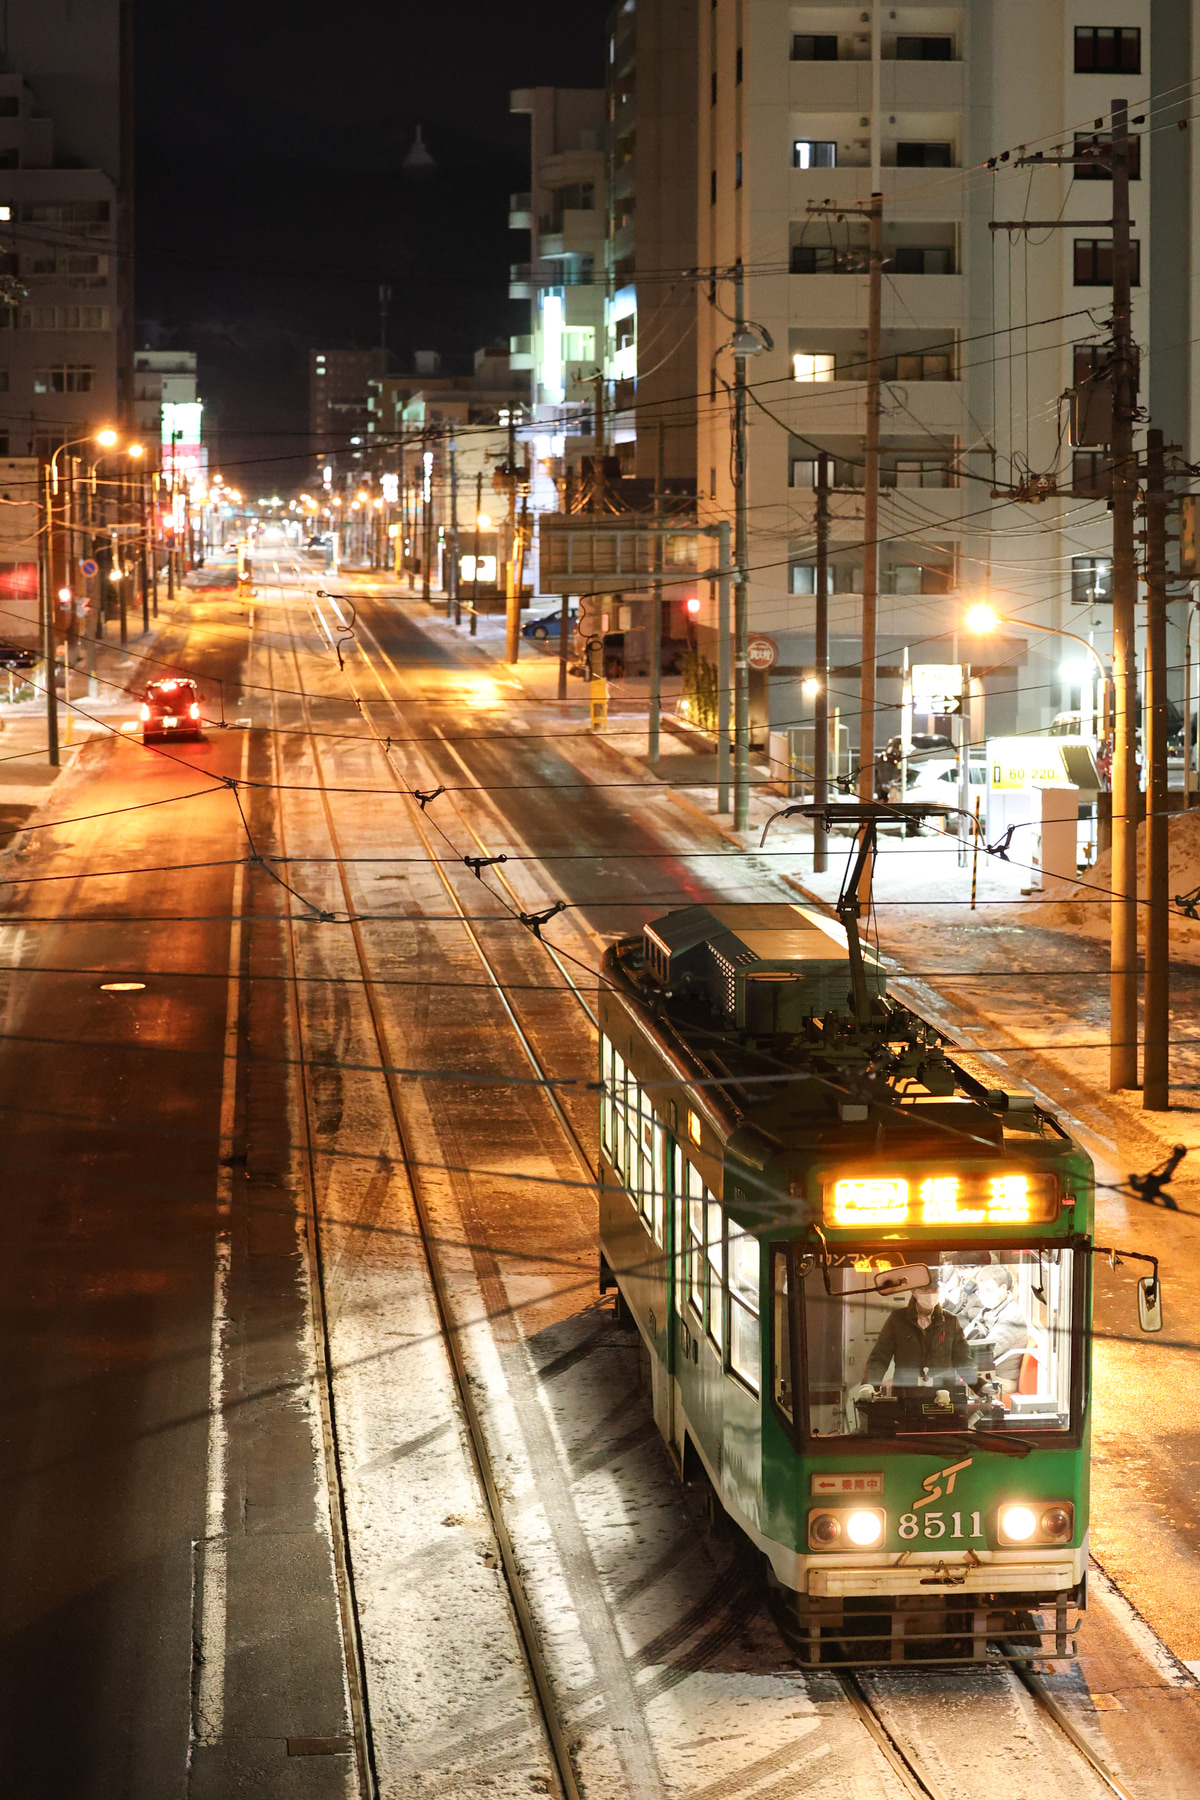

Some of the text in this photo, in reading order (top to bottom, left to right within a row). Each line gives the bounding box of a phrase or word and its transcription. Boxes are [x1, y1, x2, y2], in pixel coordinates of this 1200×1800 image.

[819, 1253, 873, 1266] ワンマン
[897, 1511, 984, 1540] 8511
